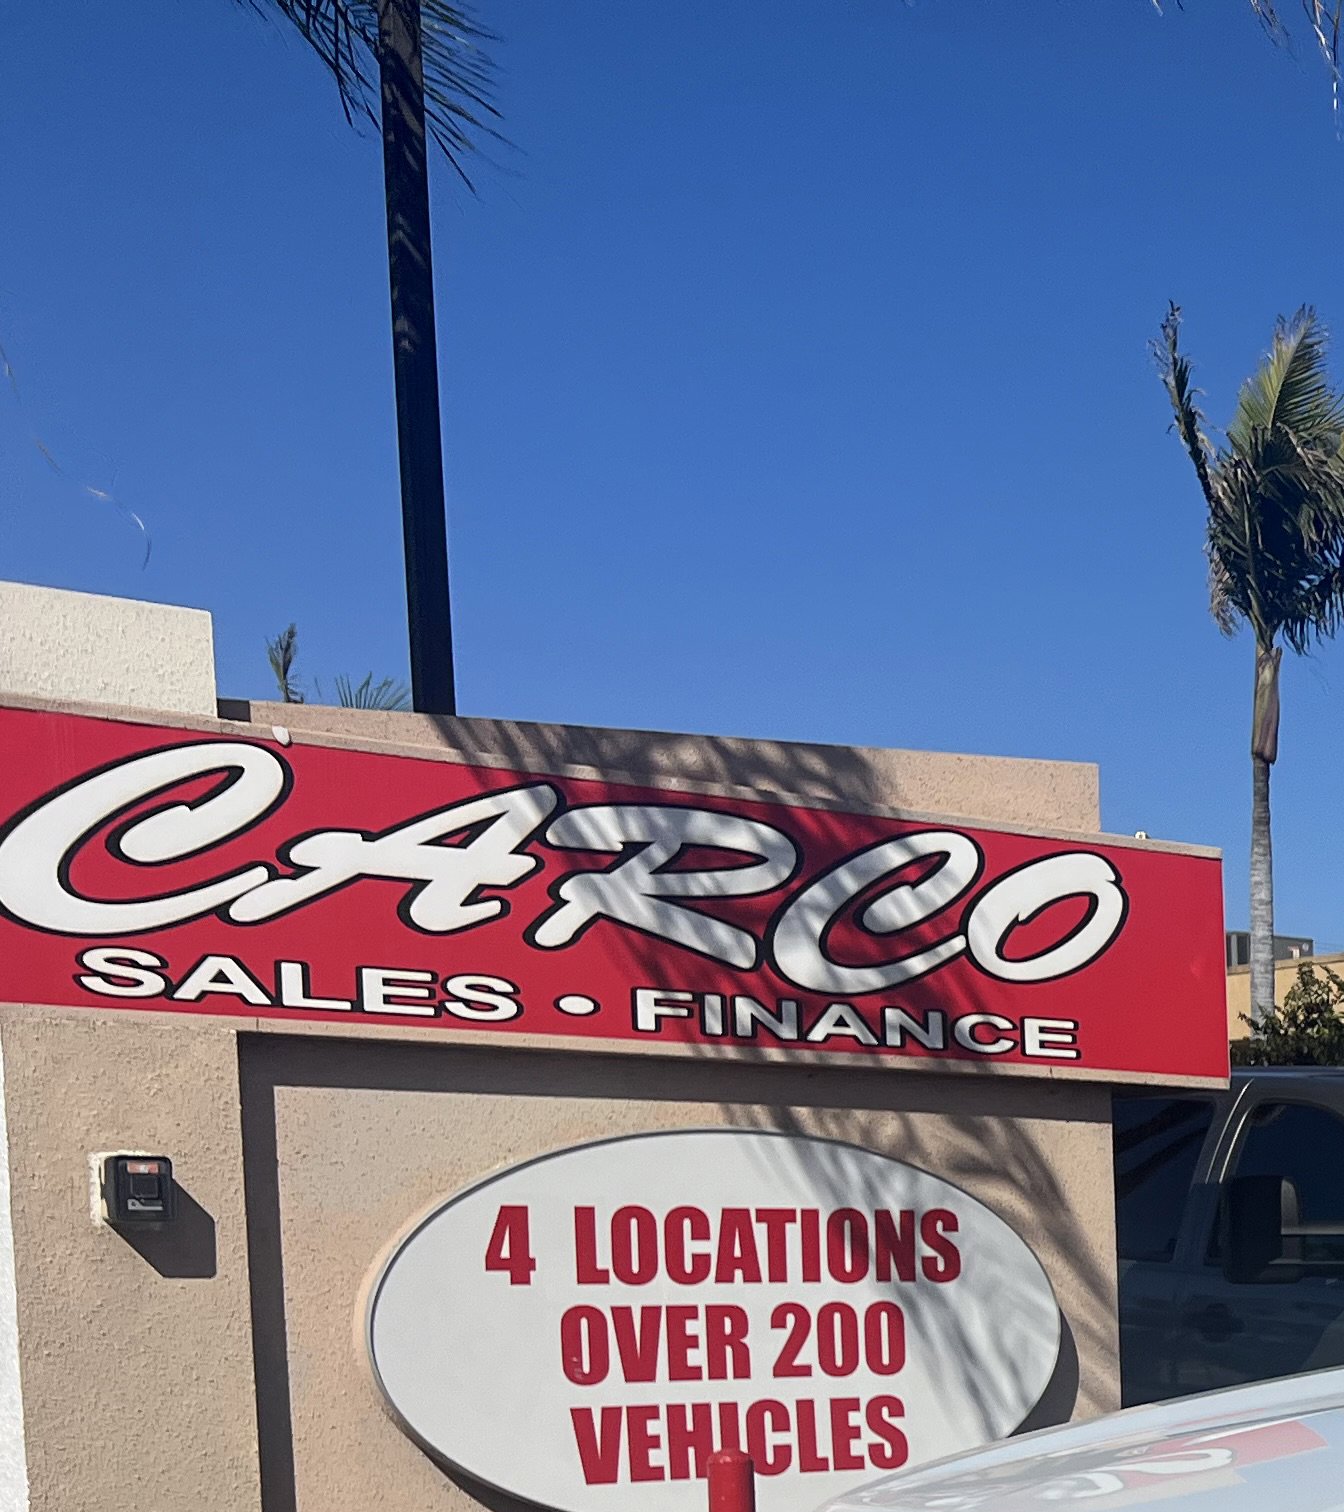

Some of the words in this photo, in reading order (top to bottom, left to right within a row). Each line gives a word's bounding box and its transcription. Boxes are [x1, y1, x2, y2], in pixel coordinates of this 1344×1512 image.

[0, 740, 1129, 993] CARCO
[75, 946, 522, 1023] SALES
[631, 985, 1084, 1060] FINANCE
[484, 1205, 536, 1287] 4
[574, 1205, 962, 1286] LOCATIONS
[559, 1304, 752, 1386] OVER
[770, 1301, 906, 1379] 200
[570, 1395, 909, 1486] VEHICLES
